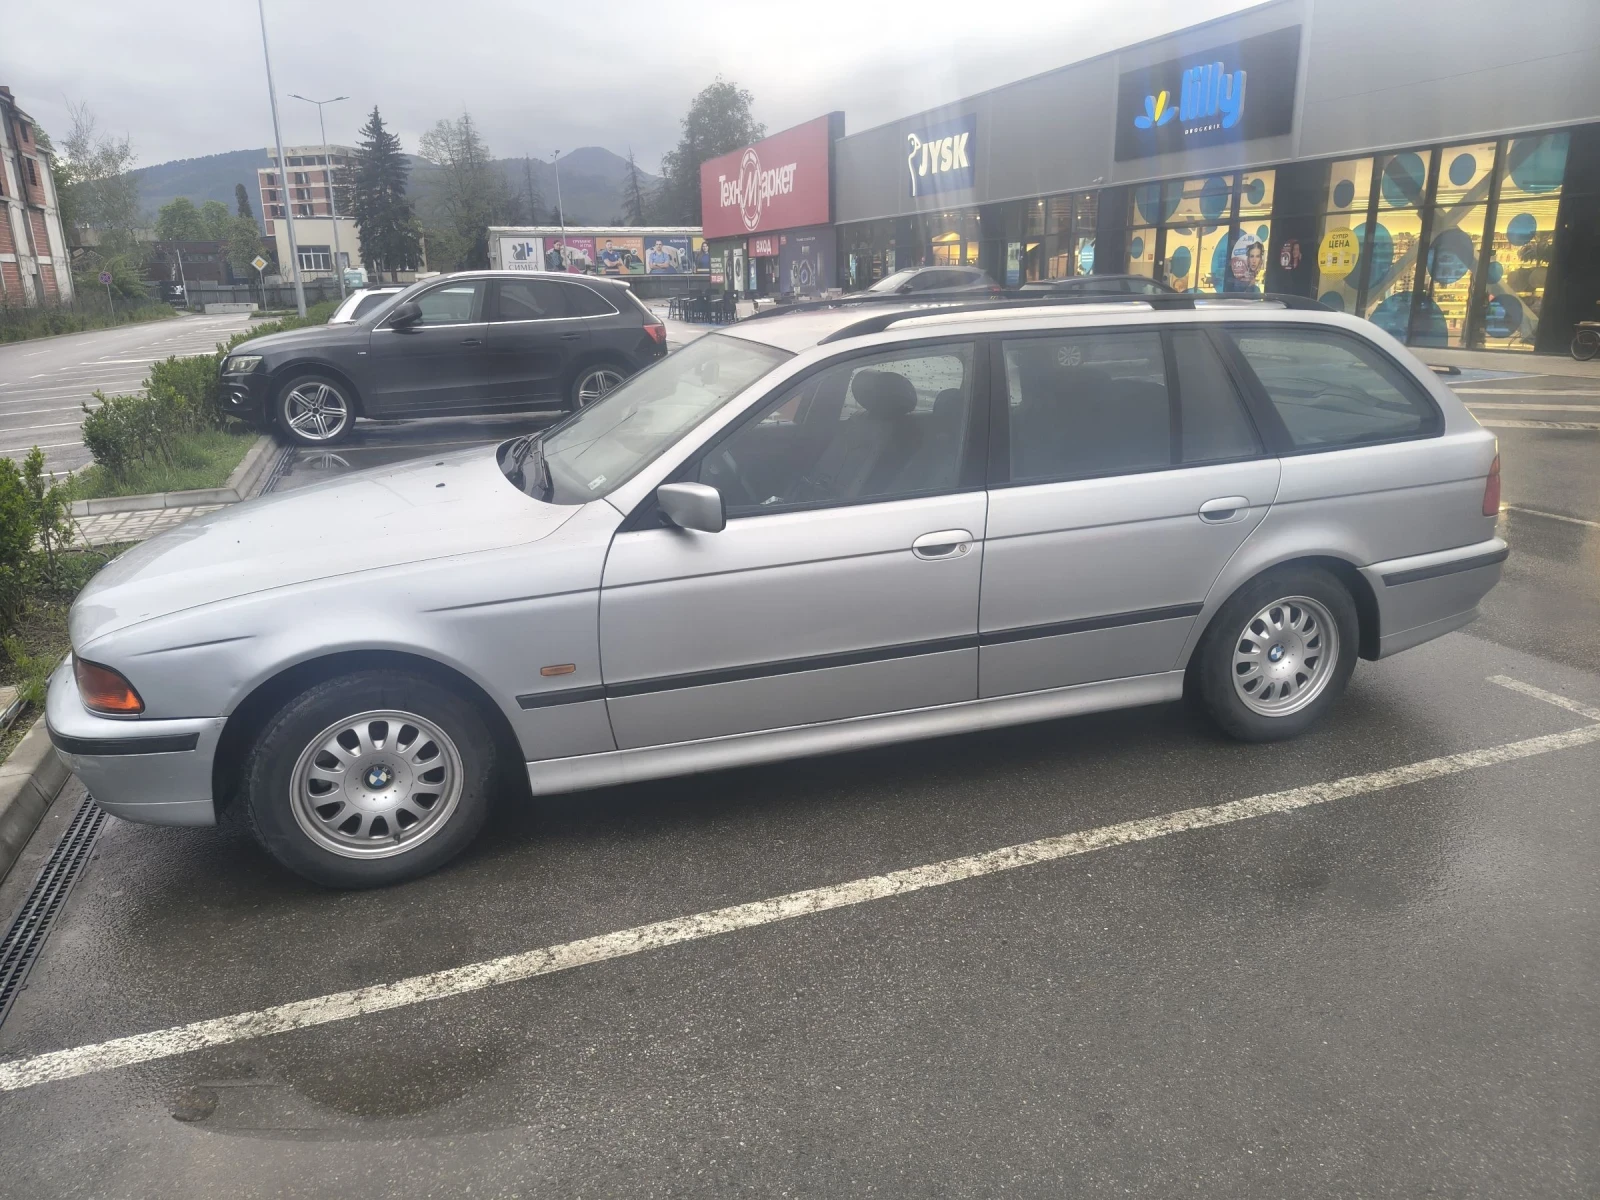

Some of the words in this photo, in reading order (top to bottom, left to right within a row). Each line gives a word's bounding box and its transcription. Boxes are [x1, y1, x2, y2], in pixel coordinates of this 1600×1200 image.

[1179, 61, 1247, 129] lilly
[918, 132, 969, 177] JYSK
[756, 240, 772, 254] ВХОД
[1328, 239, 1350, 249] ЦЕНА
[508, 263, 539, 271] СИМБА
